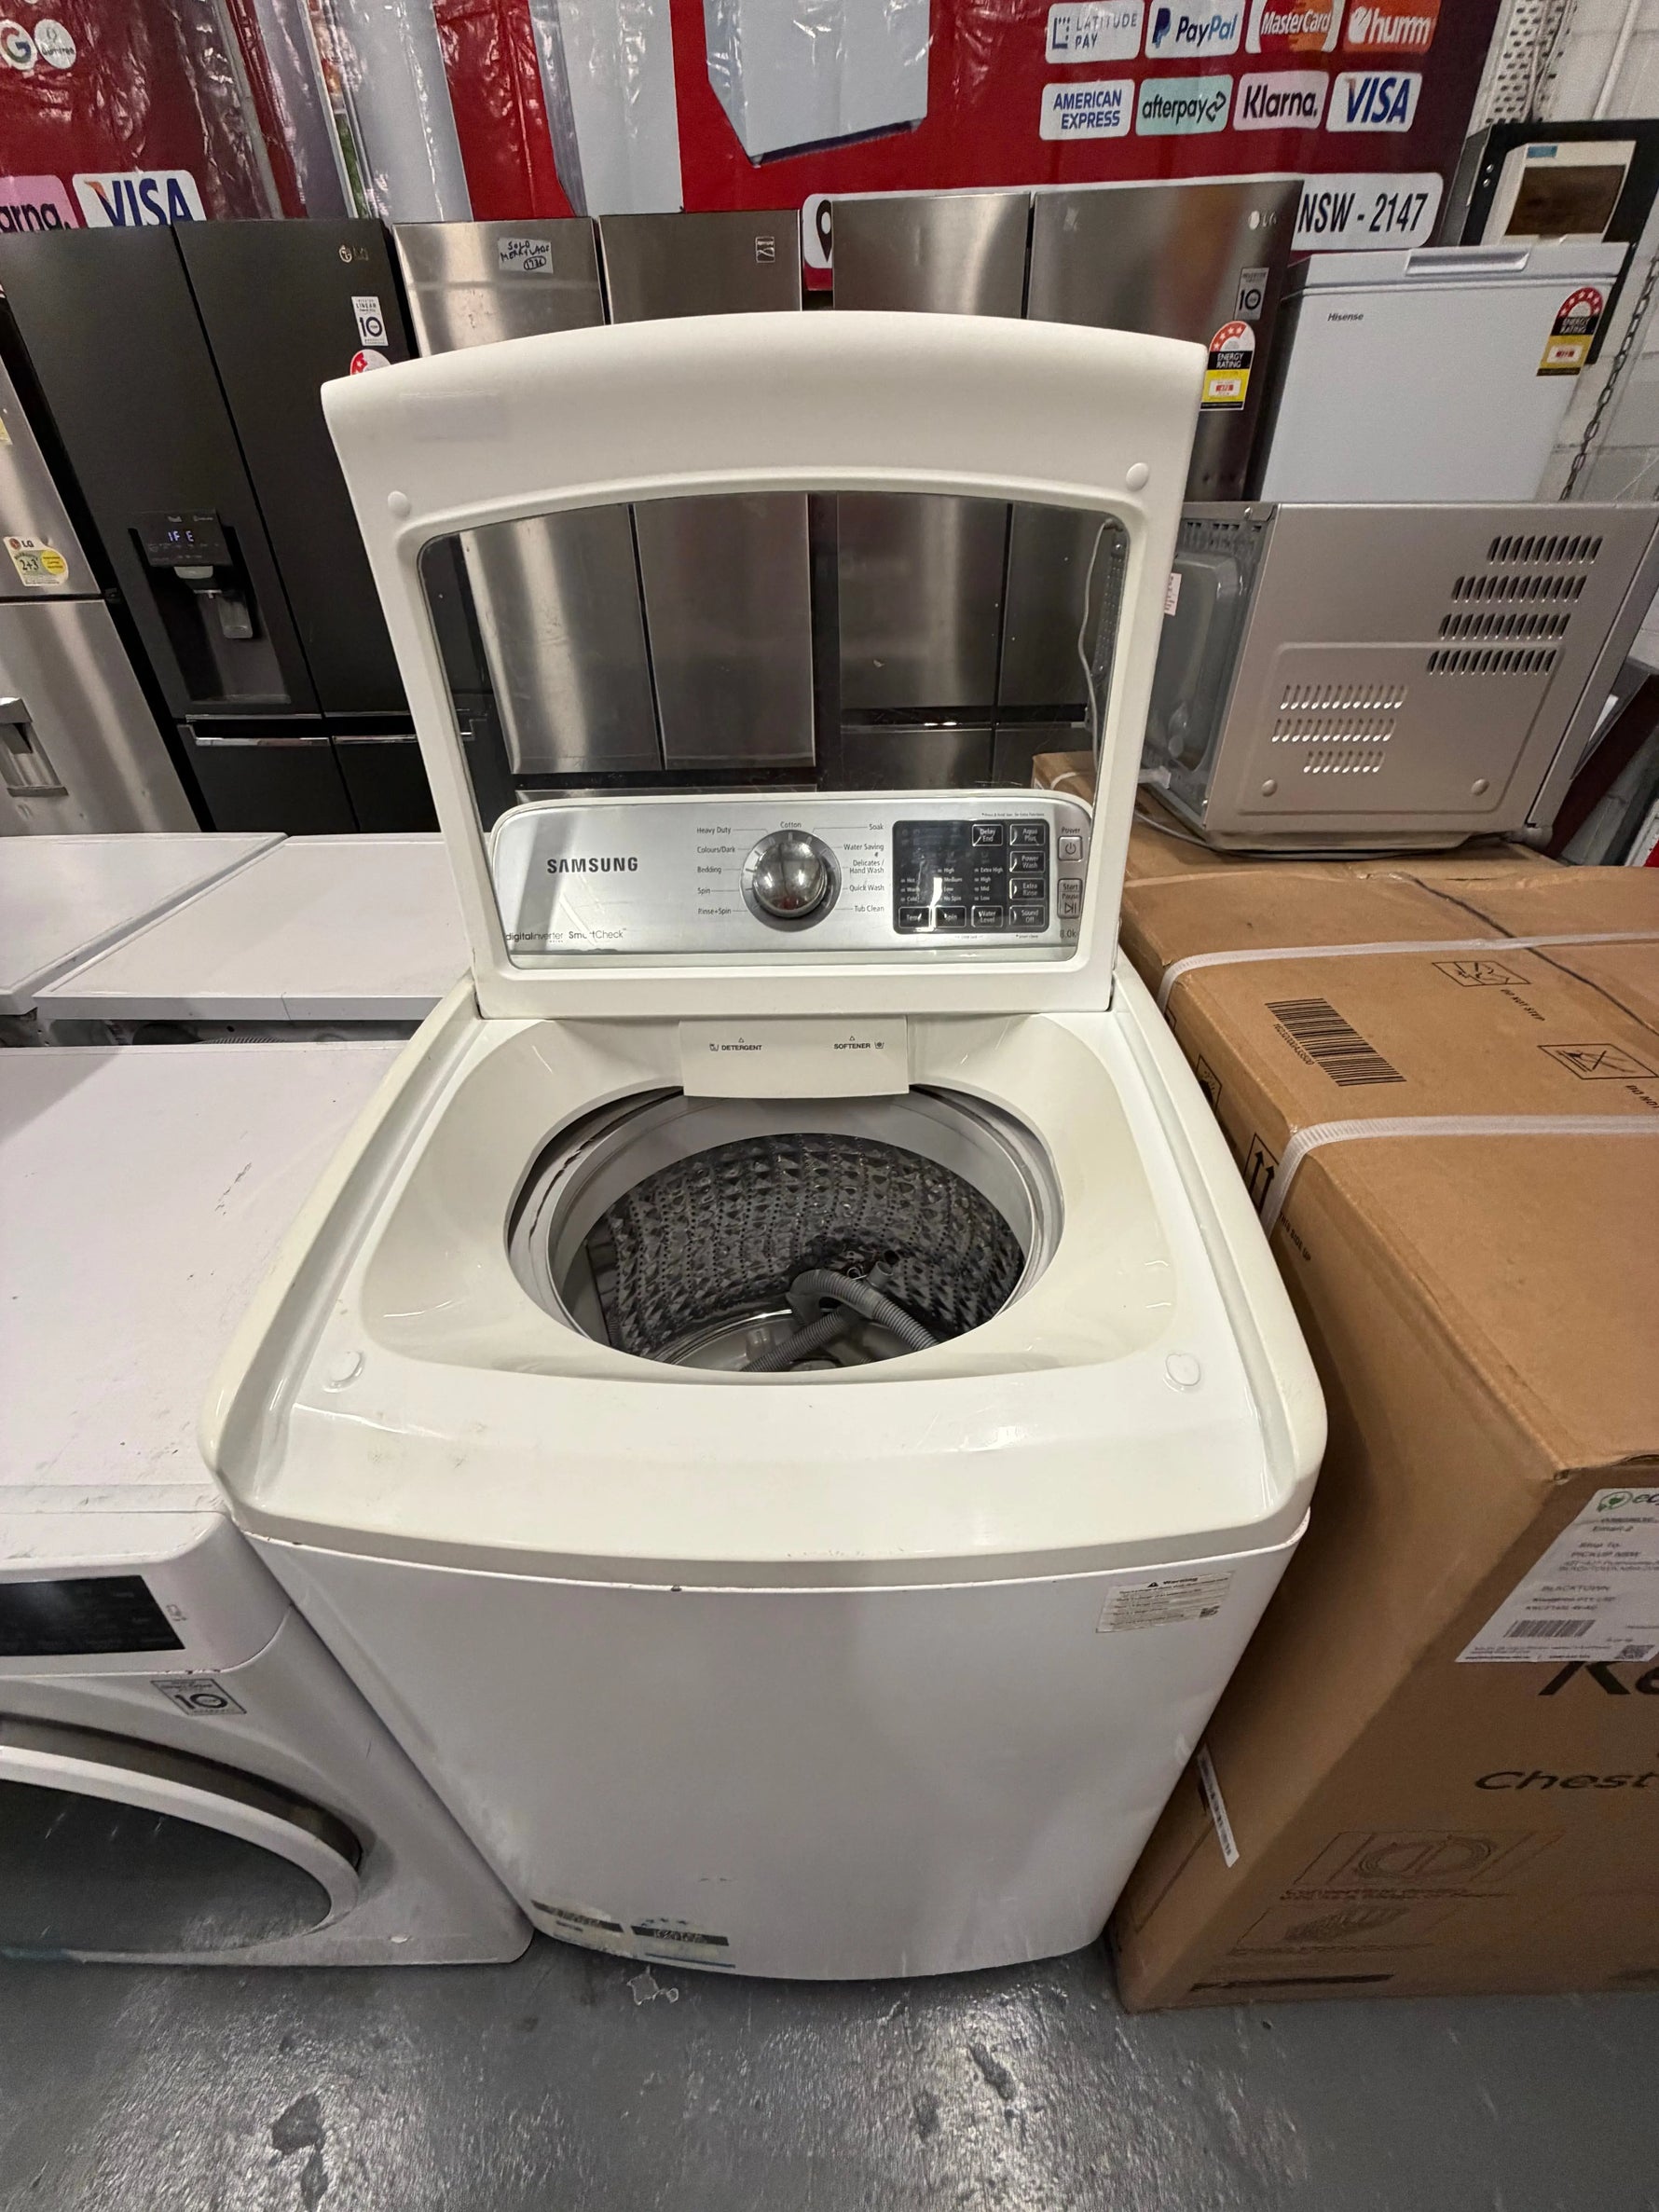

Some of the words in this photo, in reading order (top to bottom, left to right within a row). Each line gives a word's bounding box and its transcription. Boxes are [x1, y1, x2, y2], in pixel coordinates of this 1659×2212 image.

[1075, 13, 1138, 31] LATITUDE
[1175, 15, 1238, 44] PayPal
[1261, 11, 1331, 35] MasterCard
[1372, 14, 1433, 46] humm
[1075, 33, 1098, 49] PAY
[1053, 90, 1122, 112] AMERICAN
[1242, 85, 1318, 119] Klarna.
[1345, 77, 1411, 124] VISA
[1061, 111, 1120, 131] EXPRESS
[1142, 98, 1209, 124] afterpay
[86, 177, 193, 227] VISA
[1297, 194, 1354, 234] NSW
[1369, 193, 1428, 233] 2147
[1239, 288, 1261, 311] 10
[359, 316, 383, 337] 10
[1327, 312, 1364, 322] Hisense
[696, 827, 715, 835] Heavy
[716, 826, 732, 834] Duty
[980, 828, 996, 837] Delay
[696, 845, 735, 854] Colours/Dark
[863, 843, 884, 852] Saving
[547, 857, 638, 874] SAMSUNG
[697, 865, 722, 874] Bedding
[697, 886, 711, 895] Spin
[866, 904, 884, 913] Clean
[1060, 929, 1079, 939] 8.0k
[1475, 1770, 1659, 1790] Chest
